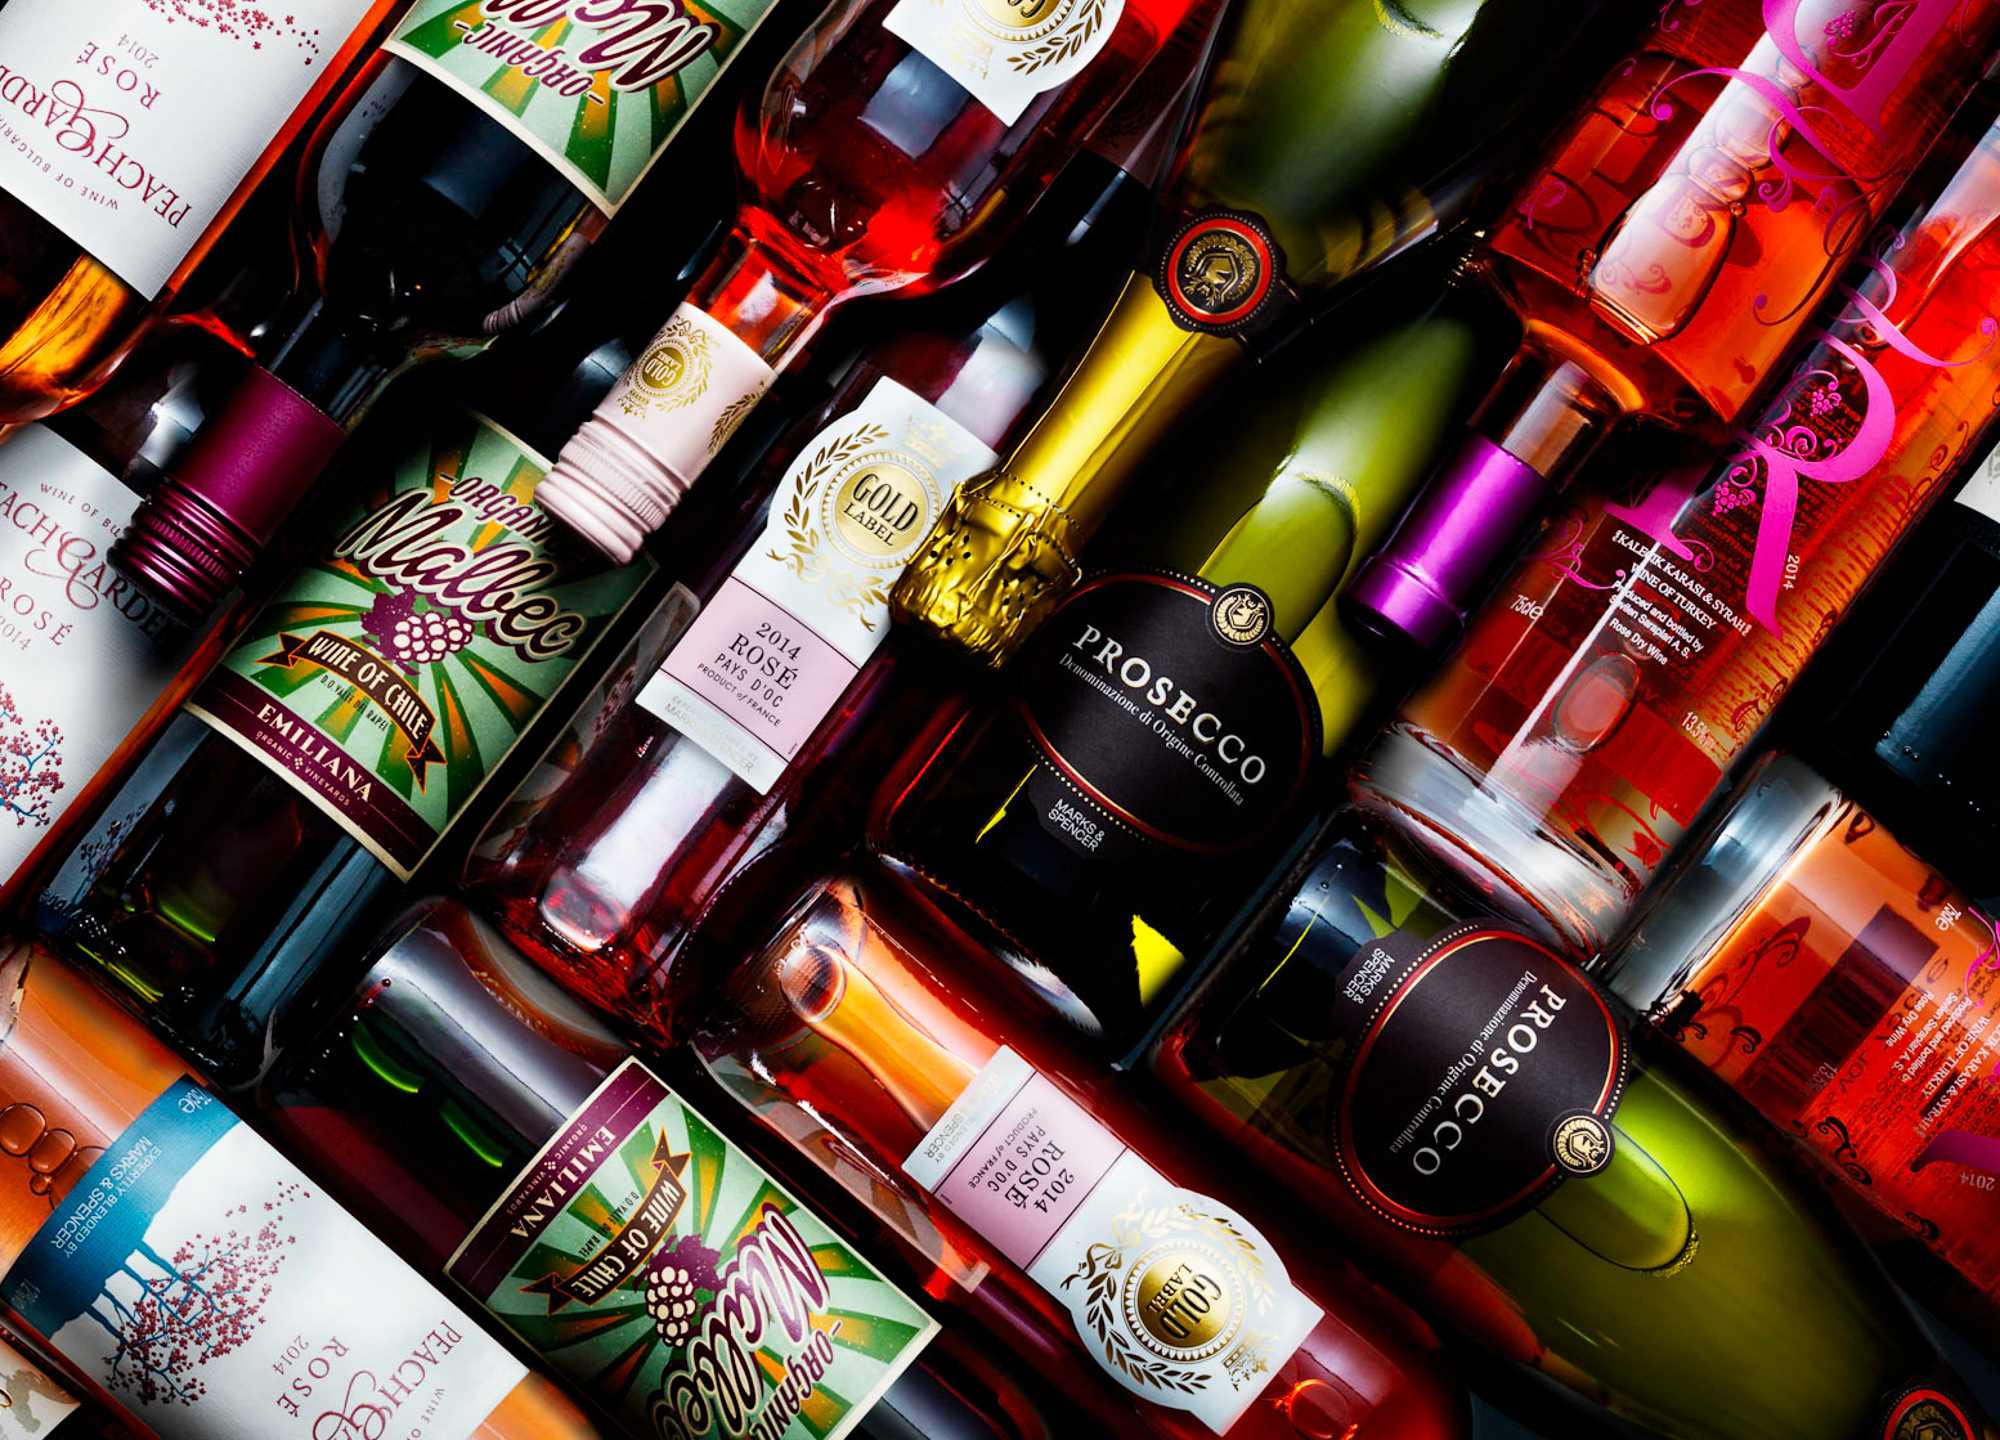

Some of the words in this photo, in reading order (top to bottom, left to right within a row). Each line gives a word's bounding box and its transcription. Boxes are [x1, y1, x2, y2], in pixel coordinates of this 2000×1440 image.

[119, 33, 159, 69] 2014
[76, 41, 162, 110] ROSÉ
[0, 115, 51, 173] BULGARI
[55, 172, 74, 188] OF
[81, 186, 119, 210] WINE
[93, 142, 192, 228] PEACH
[645, 358, 677, 386] GOLD
[657, 350, 682, 372] LABEL
[0, 482, 60, 547] ACH
[40, 482, 76, 505] WINE
[81, 502, 99, 518] OF
[449, 477, 554, 546] ORGAN
[851, 472, 920, 534] GOLD
[842, 503, 894, 547] LABEL
[25, 531, 168, 640] GARDE
[334, 487, 587, 662] Malbec
[1617, 533, 1666, 572] KALEIK
[1662, 563, 1705, 598] KARASI
[1702, 592, 1713, 602] &
[1710, 598, 1747, 634] SYRAH
[1782, 554, 1800, 590] 2014
[0, 576, 73, 646] ROSÉ
[1658, 582, 1675, 599] OF
[1673, 591, 1718, 630] TURKEY
[755, 621, 803, 662] 2014
[1610, 617, 1633, 639] Rose
[1631, 631, 1651, 652] Dry
[1646, 642, 1668, 665] Wine
[1649, 605, 1668, 623] and
[1666, 615, 1694, 645] bottled
[1692, 637, 1704, 652] by
[728, 632, 801, 691] ROSÉ
[1680, 645, 1690, 659] S.
[308, 637, 362, 672] WINE
[357, 662, 389, 690] OF
[385, 684, 428, 740] CHILE
[698, 662, 739, 695] PRODUCT
[736, 690, 749, 703] of
[746, 699, 781, 728] FRANCE
[713, 653, 749, 684] PAYS
[751, 674, 784, 709] D'OC
[366, 710, 388, 732] RAPEL
[1072, 624, 1266, 784] PROSECCO
[1059, 653, 1140, 717] Denominazione
[1139, 709, 1154, 726] di
[1152, 718, 1194, 760] Origine
[1193, 753, 1244, 806] Controllata
[255, 702, 373, 802] EMILIANA
[256, 730, 293, 761] ORGANIC
[304, 765, 351, 807] VINEYARDS
[1048, 808, 1099, 852] SPENCER
[1055, 798, 1097, 836] MARKS
[1095, 829, 1106, 842] &
[1342, 948, 1386, 999] SPENCER
[1362, 955, 1395, 997] MARKS
[1352, 992, 1365, 1005] &
[1481, 970, 1538, 1042] Denominazione
[1901, 1007, 1920, 1026] Dry
[1914, 991, 1934, 1012] Rose
[1470, 1040, 1484, 1057] di
[1885, 1021, 1908, 1048] Wine
[1929, 1031, 1944, 1047] and
[1954, 1041, 1970, 1059] OF
[1964, 1016, 1990, 1045] WINE
[1413, 984, 1567, 1175] PROSECCO
[1439, 1053, 1476, 1097] Origine
[1907, 1045, 1934, 1077] bottled
[1922, 1056, 1960, 1099] TURKEY
[1954, 1047, 1990, 1089] KARASI
[1946, 1085, 1959, 1096] &
[1006, 1108, 1038, 1146] PRODUCT
[1390, 1096, 1443, 1153] Controllata
[1919, 1095, 1951, 1131] SYRAH
[555, 1124, 588, 1160] ORGANIC
[924, 1113, 964, 1159] SPENCER
[994, 1145, 1005, 1157] of
[1016, 1125, 1046, 1158] PAYS
[109, 1136, 153, 1181] MARKS
[117, 1147, 162, 1197] EXPERTLY
[935, 1153, 946, 1164] BY
[968, 1155, 998, 1189] FRANCE
[987, 1159, 1018, 1192] D'OC
[1004, 1139, 1065, 1209] ROSÉ
[100, 1175, 114, 1190] &
[507, 1171, 547, 1215] VINEYARDS
[510, 1126, 617, 1238] EMILIANA
[1034, 1168, 1074, 1213] 2014
[1961, 1173, 1996, 1191] 2014
[50, 1187, 105, 1249] SPENCER
[75, 1195, 118, 1243] BLENDED
[641, 1180, 681, 1233] WINE
[65, 1243, 79, 1258] BY
[578, 1235, 600, 1261] RAPEL
[620, 1228, 649, 1261] OF
[571, 1254, 626, 1297] CHILE
[1145, 1261, 1193, 1314] LABEL
[1158, 1272, 1222, 1340] GOLD
[273, 1335, 309, 1376] 2014
[277, 1336, 350, 1418] ROSÉ
[379, 1320, 463, 1409] PEACH
[421, 1388, 445, 1423] WINE
